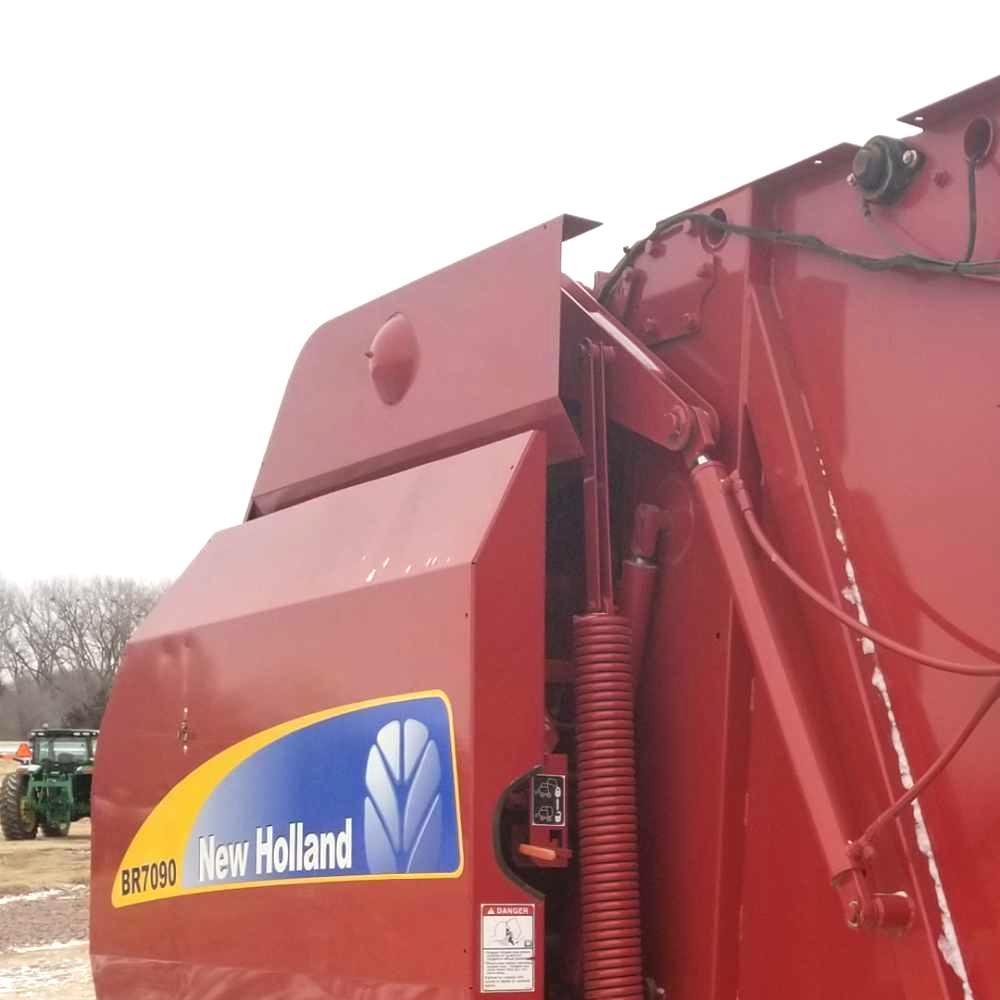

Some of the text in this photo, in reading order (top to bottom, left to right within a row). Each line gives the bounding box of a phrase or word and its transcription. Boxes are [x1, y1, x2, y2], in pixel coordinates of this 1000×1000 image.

[198, 818, 352, 882] New Holland
[121, 859, 177, 896] BR7090
[496, 907, 529, 915] DANGER
